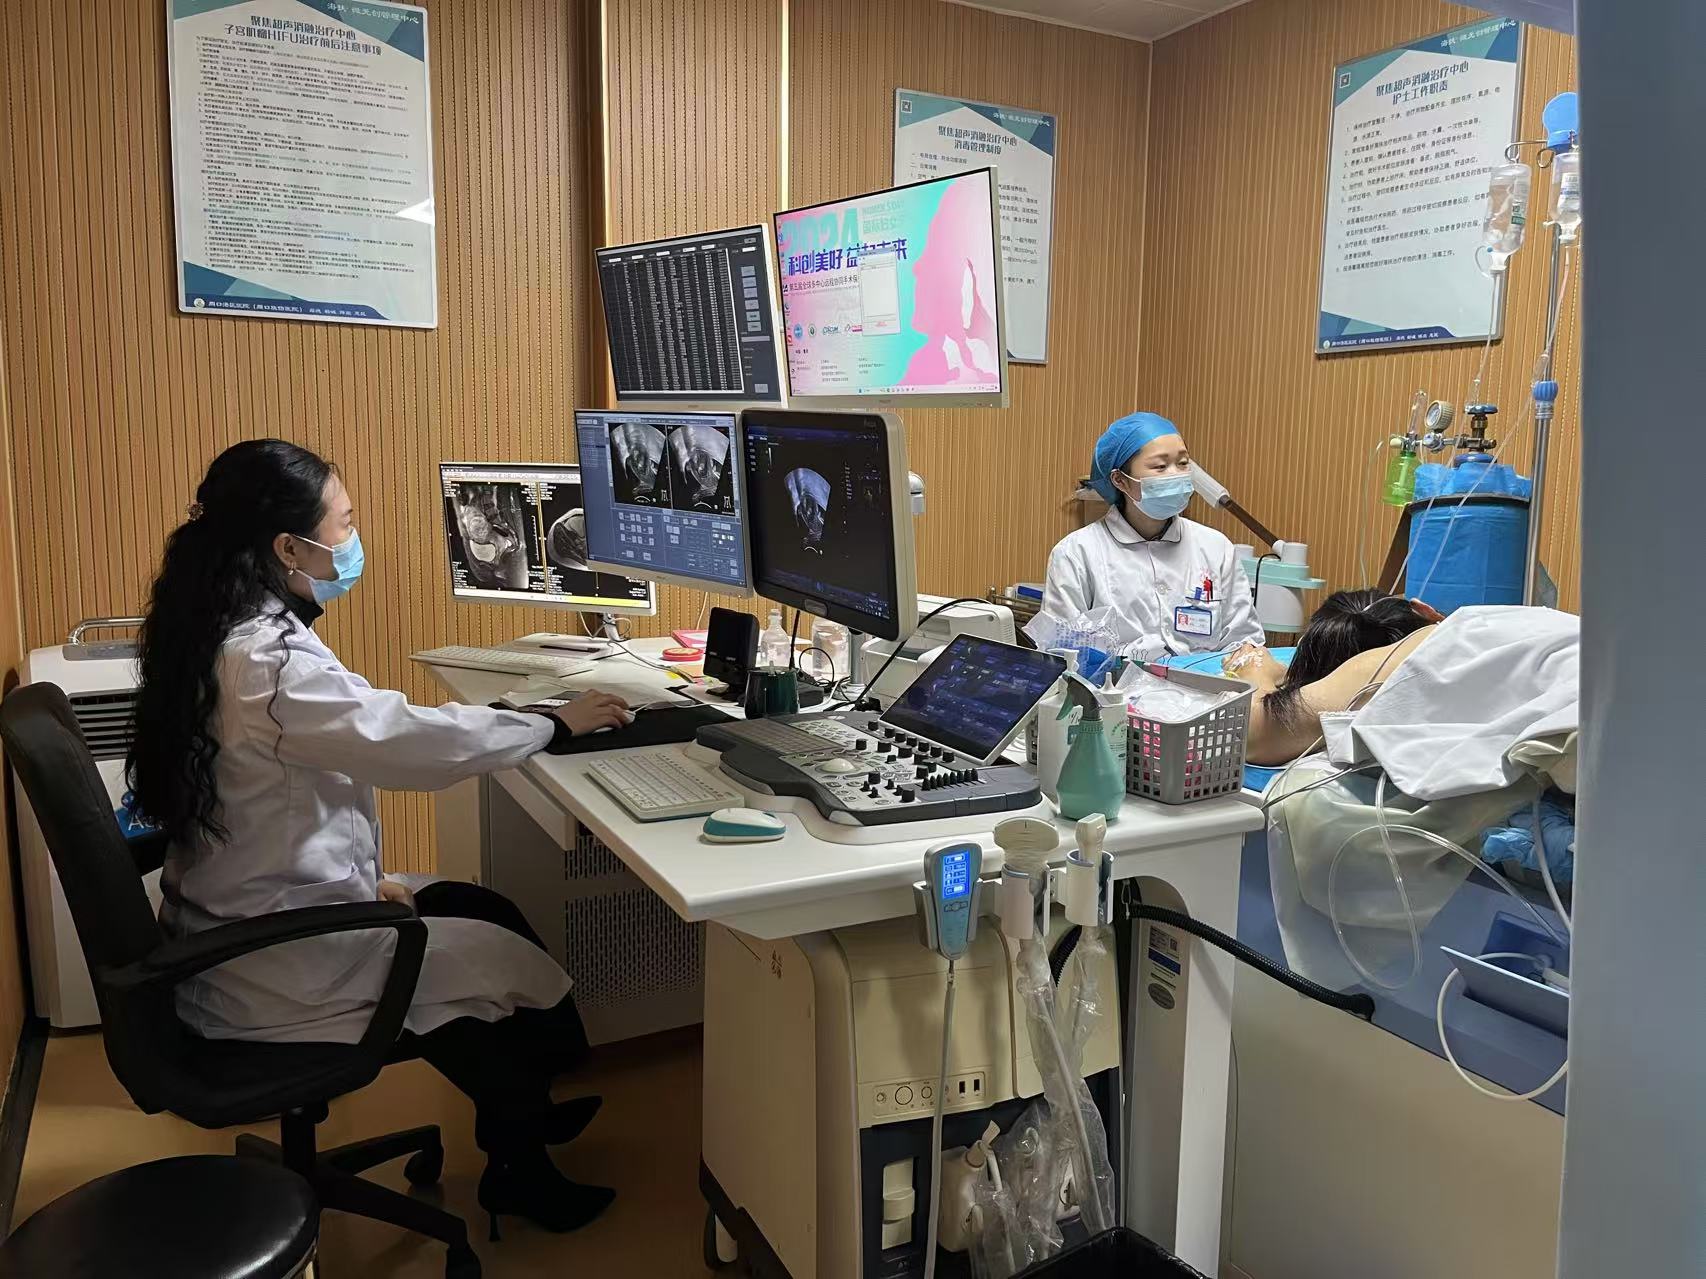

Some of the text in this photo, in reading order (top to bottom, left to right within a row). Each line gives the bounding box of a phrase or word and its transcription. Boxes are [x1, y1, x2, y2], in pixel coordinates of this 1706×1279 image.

[224, 24, 382, 56] 子宫肌瘤HIFU治疗前后注意事项
[250, 15, 356, 41] 聚焦超声消融治疗中心
[1376, 60, 1469, 97] 聚焦超声消融治疗中心
[1392, 83, 1449, 105] 护士工作职责
[938, 125, 1018, 147] 聚焦超声消融治疗中心
[954, 139, 1002, 155] 消毒管理制度
[788, 248, 844, 277] 科创美好
